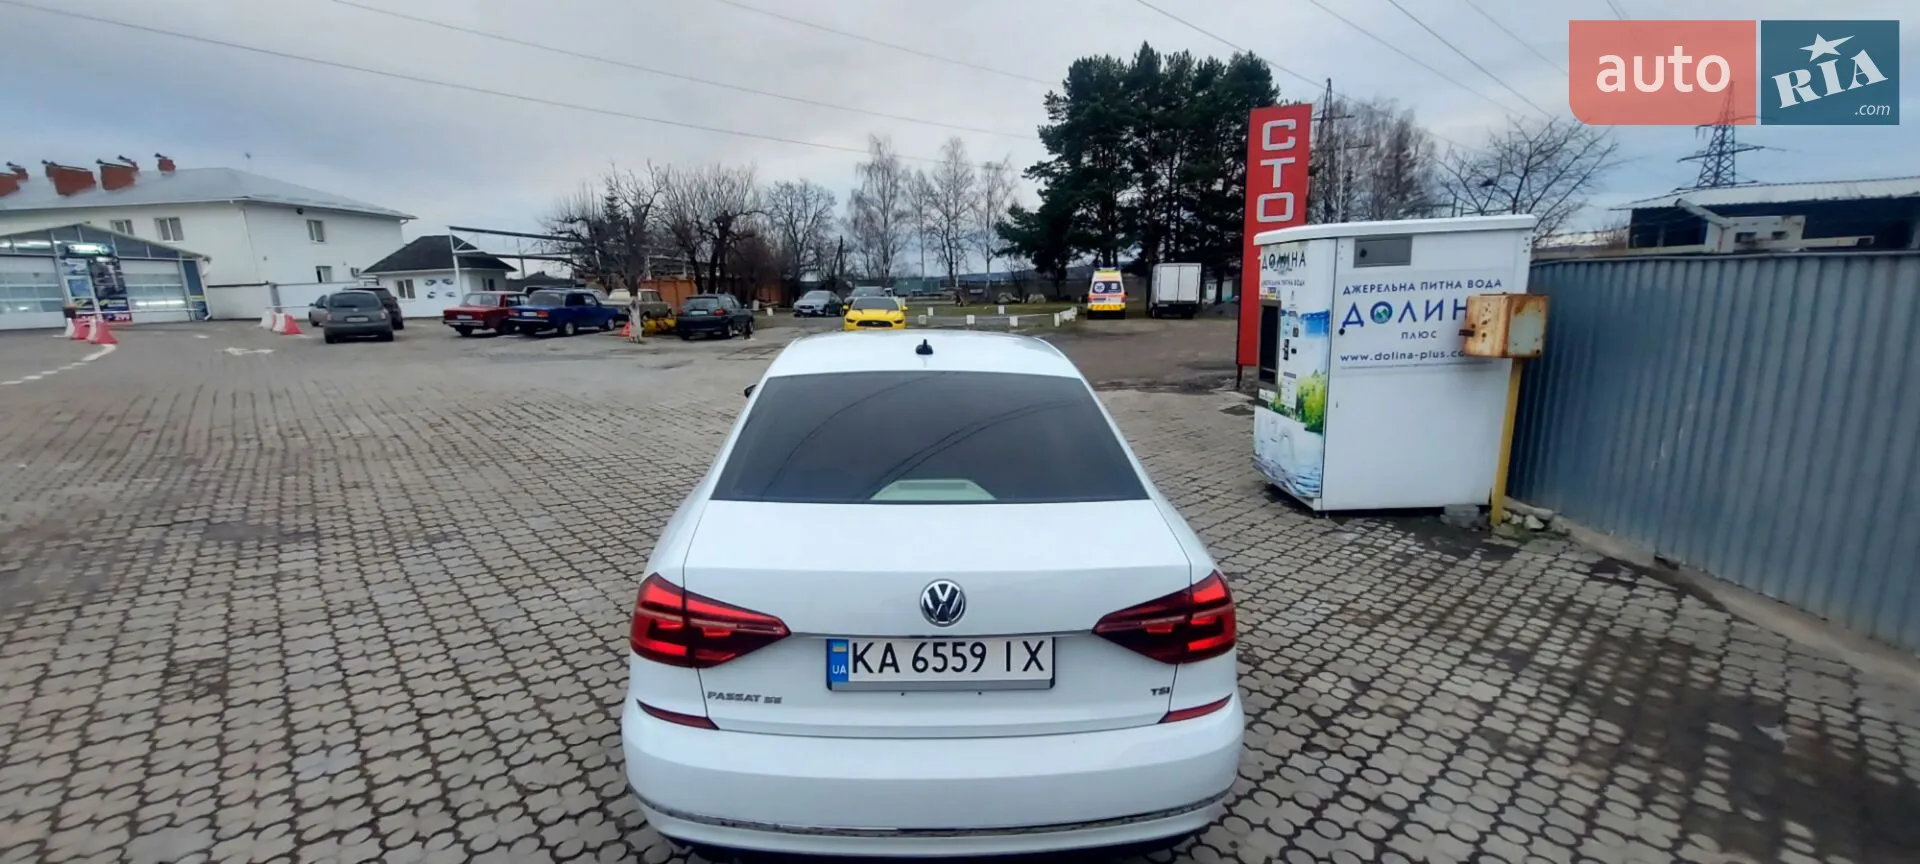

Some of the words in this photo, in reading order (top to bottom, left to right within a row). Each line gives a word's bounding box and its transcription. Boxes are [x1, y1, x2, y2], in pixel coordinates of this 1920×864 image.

[1256, 118, 1297, 223] СТО
[1342, 282, 1416, 295] ДЖЕРЕЛЬНА
[1420, 280, 1462, 291] ПИТНА
[1467, 279, 1502, 290] ВОДА
[1342, 298, 1467, 328] ДОЛИН
[1401, 330, 1437, 340] ПЛЮС
[1340, 350, 1465, 362] www.dolina-plus.co
[852, 642, 901, 674] KA
[911, 641, 987, 673] 6559
[1005, 640, 1045, 672] IX
[832, 664, 847, 674] UA
[707, 691, 762, 703] PASSAT
[764, 696, 782, 704] SE
[1150, 686, 1170, 696] TSI
